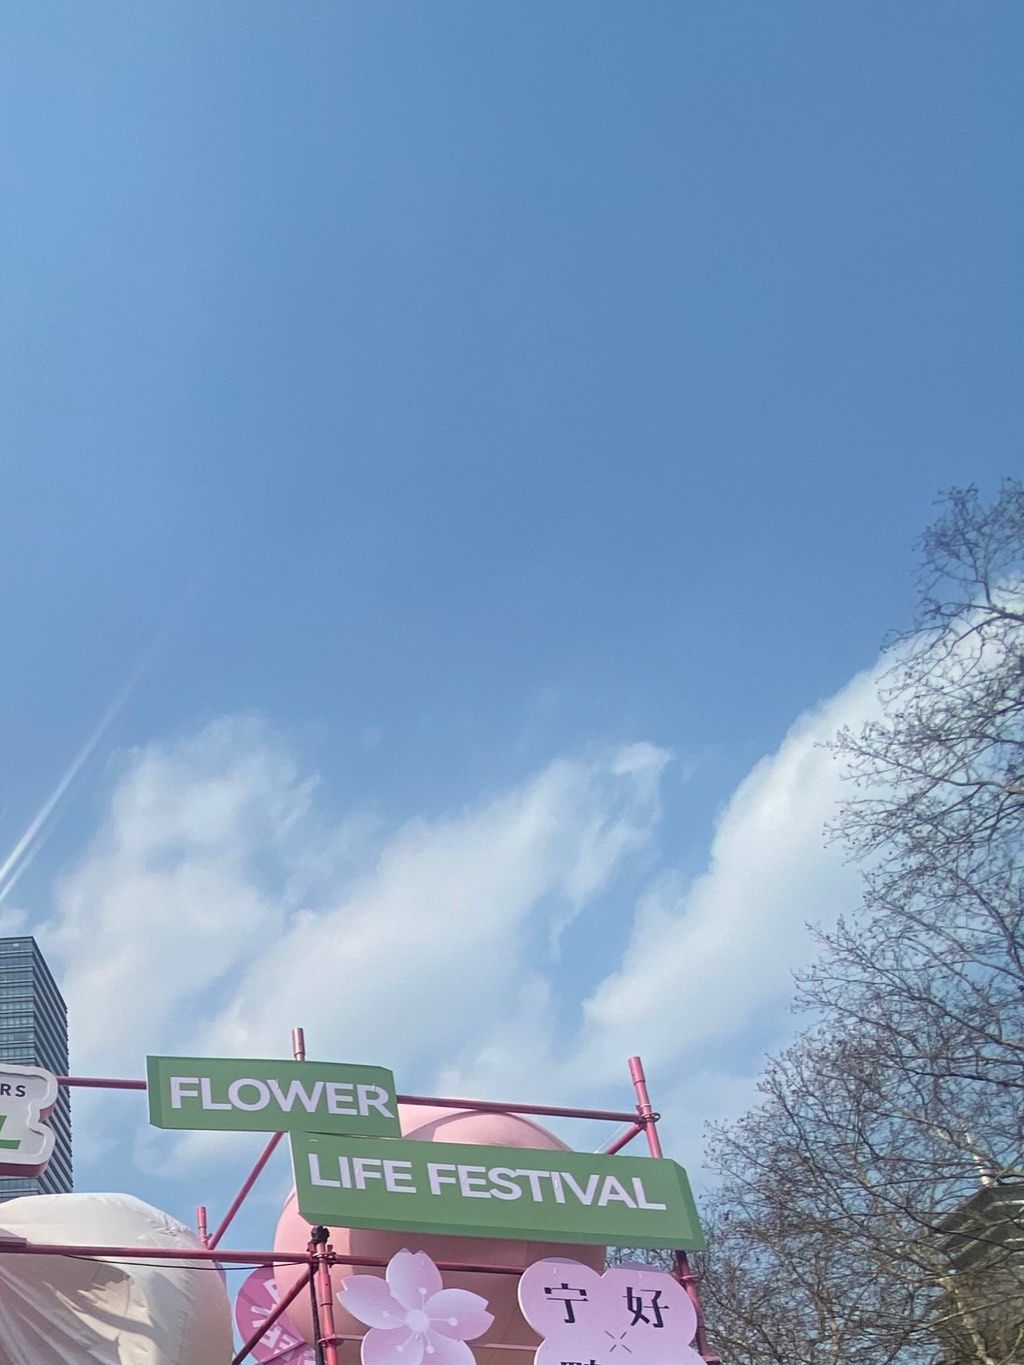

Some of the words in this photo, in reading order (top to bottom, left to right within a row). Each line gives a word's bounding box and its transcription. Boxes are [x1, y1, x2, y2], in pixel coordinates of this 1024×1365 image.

[169, 1075, 396, 1119] FLOWER
[307, 1152, 418, 1195] LIFE
[426, 1162, 669, 1212] FESTIVAL
